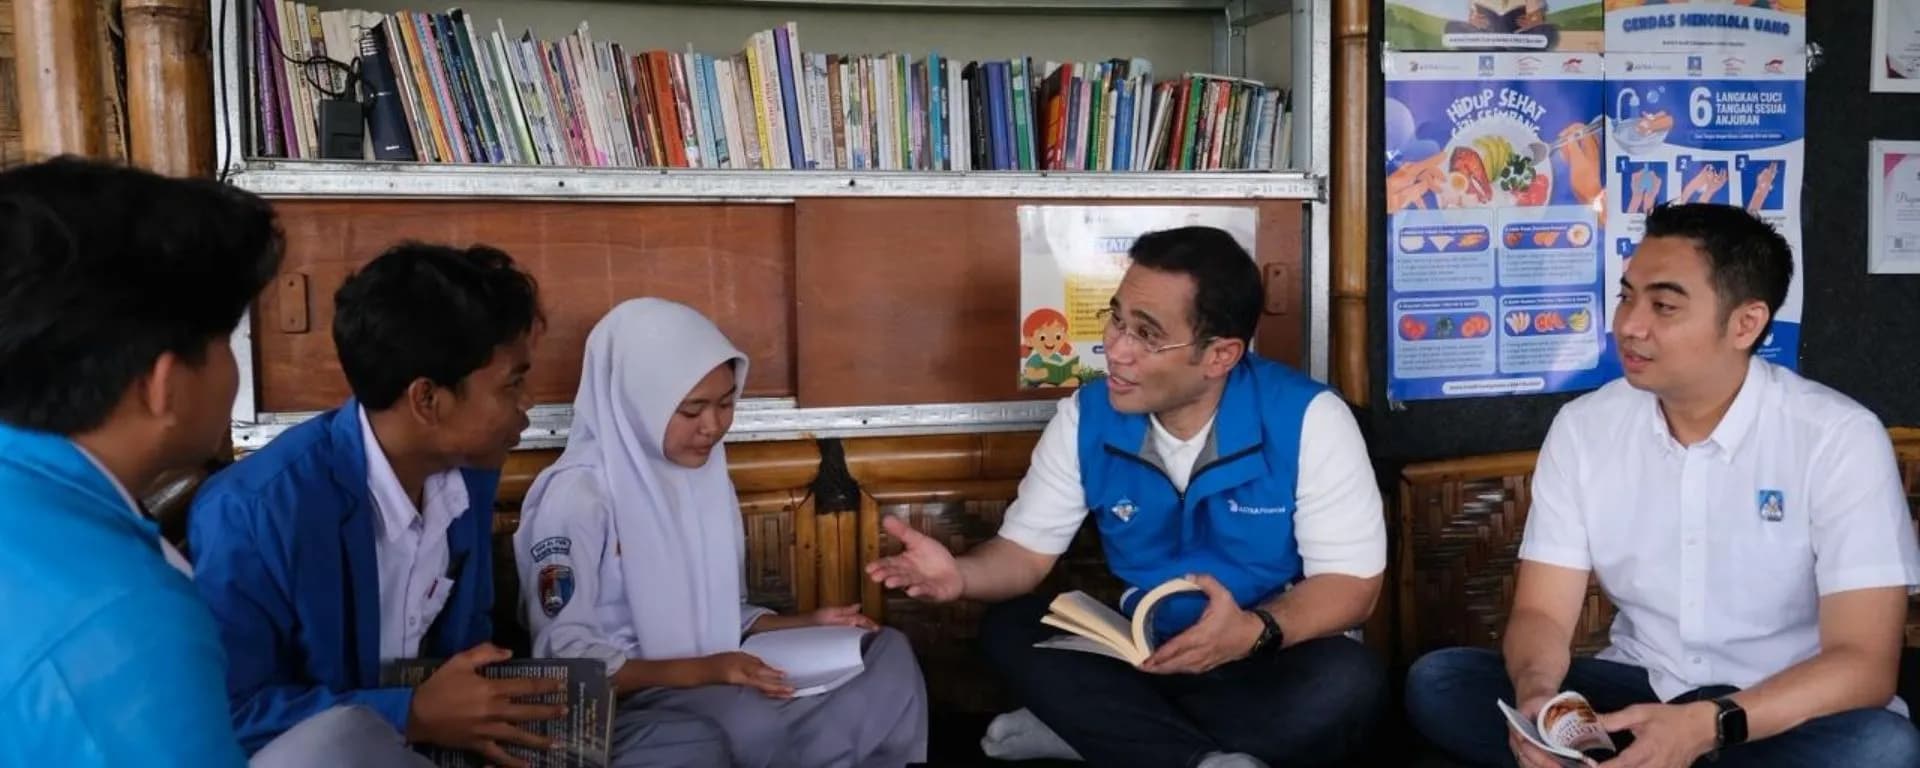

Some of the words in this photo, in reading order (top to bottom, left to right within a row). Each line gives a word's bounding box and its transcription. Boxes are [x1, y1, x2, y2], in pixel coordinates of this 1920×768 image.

[1623, 15, 1675, 33] CERDAS
[1680, 13, 1750, 30] MENGELOLA
[1754, 18, 1790, 36] UANG
[1716, 92, 1758, 102] LANGKAH
[1760, 91, 1782, 102] CUCI
[1498, 87, 1547, 122] SEHAT
[1688, 86, 1713, 127] 6
[1715, 103, 1753, 114] TANGAN
[1754, 103, 1786, 114] SESUAI
[1715, 114, 1760, 126] ANJURAN
[1620, 160, 1627, 171] 1
[1680, 158, 1688, 170] 2
[1739, 157, 1746, 169] 3
